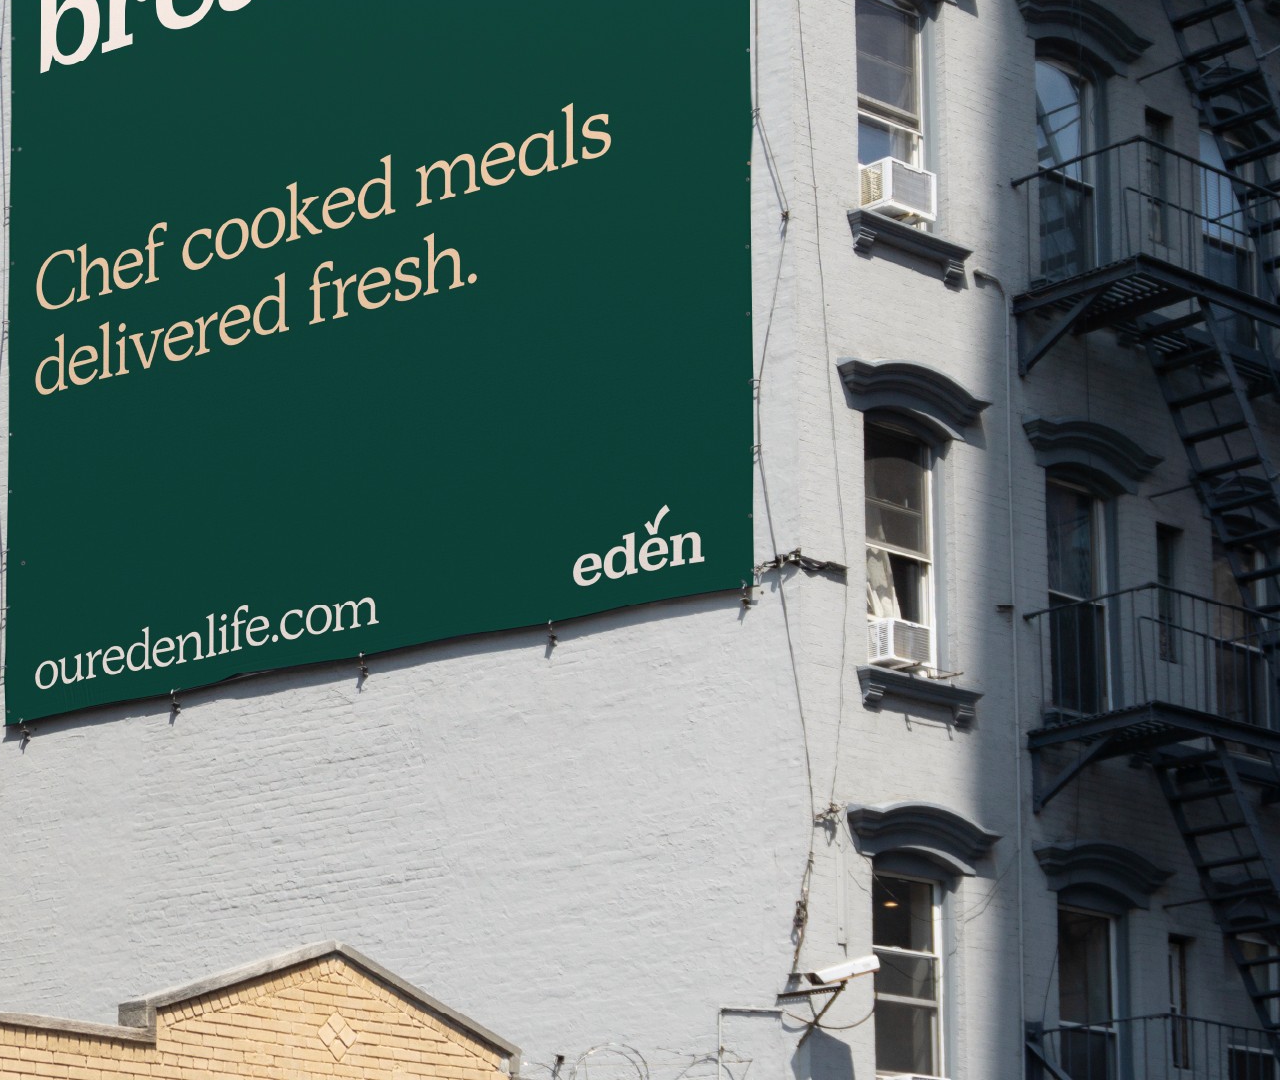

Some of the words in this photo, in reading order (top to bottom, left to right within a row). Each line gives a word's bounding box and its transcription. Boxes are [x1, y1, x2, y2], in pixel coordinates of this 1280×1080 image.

[36, 222, 167, 309] Chef
[182, 155, 395, 270] cooked
[416, 103, 612, 206] meals
[35, 273, 289, 395] delivered
[309, 233, 478, 324] fresh.
[35, 597, 379, 689] ouredenlife.com
